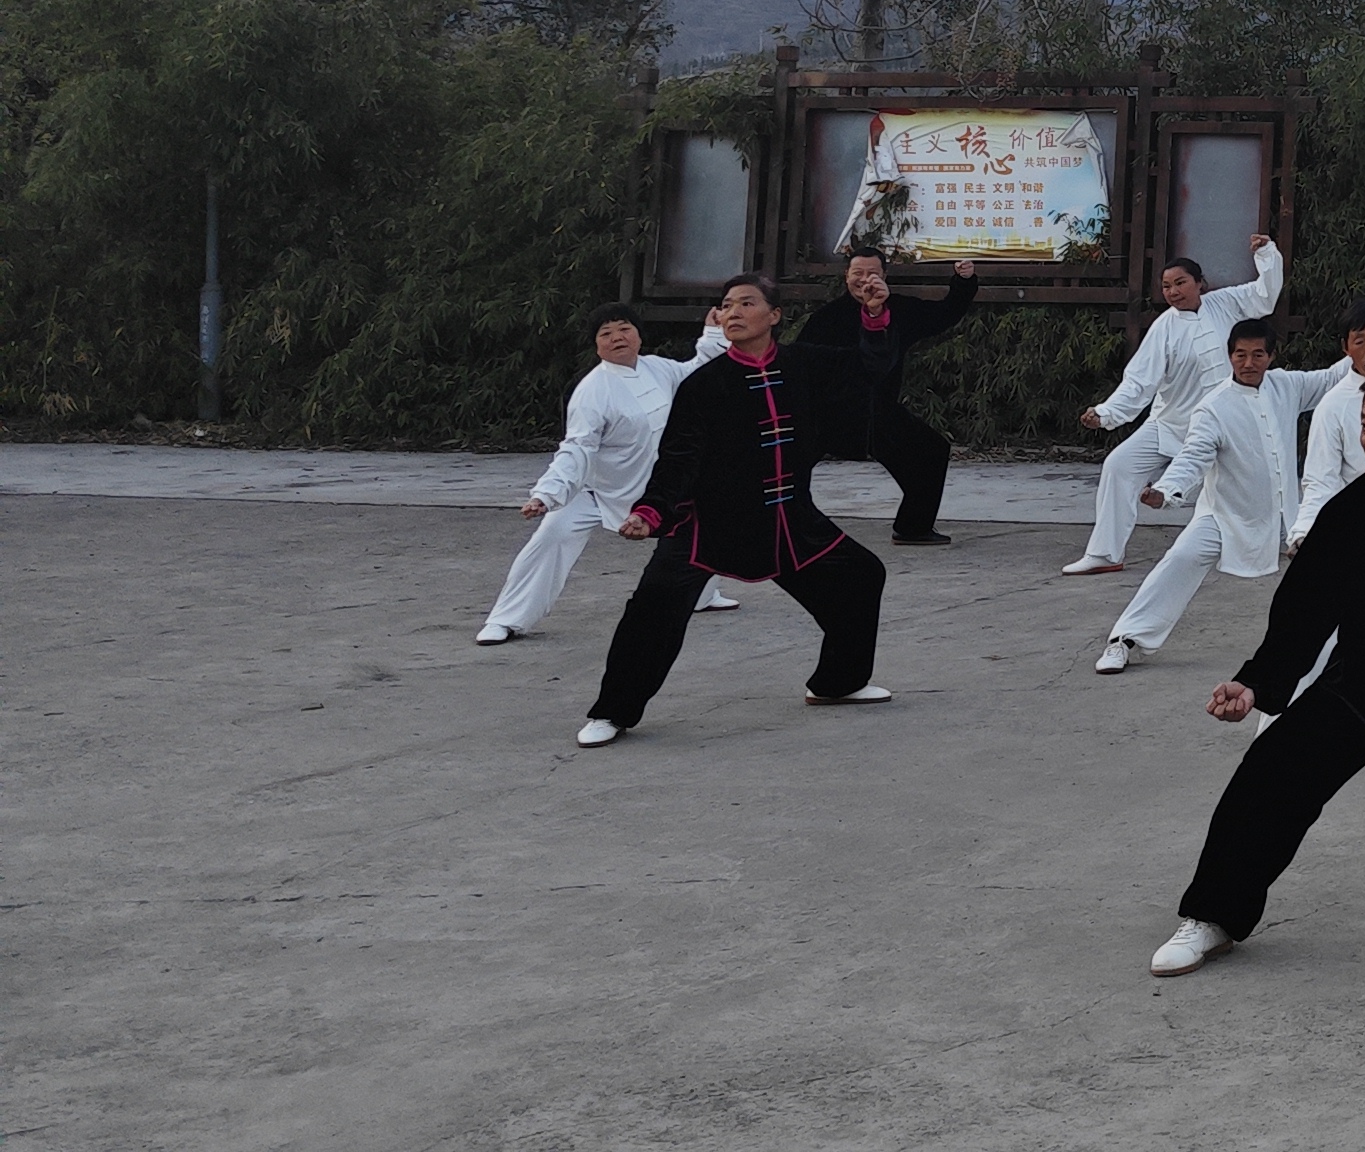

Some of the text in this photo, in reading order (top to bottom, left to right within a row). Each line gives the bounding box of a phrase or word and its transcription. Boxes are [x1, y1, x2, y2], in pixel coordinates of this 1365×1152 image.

[1024, 156, 1084, 168] 共筑中国梦
[935, 182, 957, 194] 富强
[964, 182, 986, 194] 民主
[992, 182, 1015, 194] 文明
[1021, 182, 1044, 194] 和谐
[935, 200, 957, 211] 自由
[963, 200, 986, 211] 平等
[992, 200, 1015, 211] 公正
[935, 216, 957, 228] 爱国
[963, 216, 986, 228] 敬业
[992, 216, 1015, 228] 诚信
